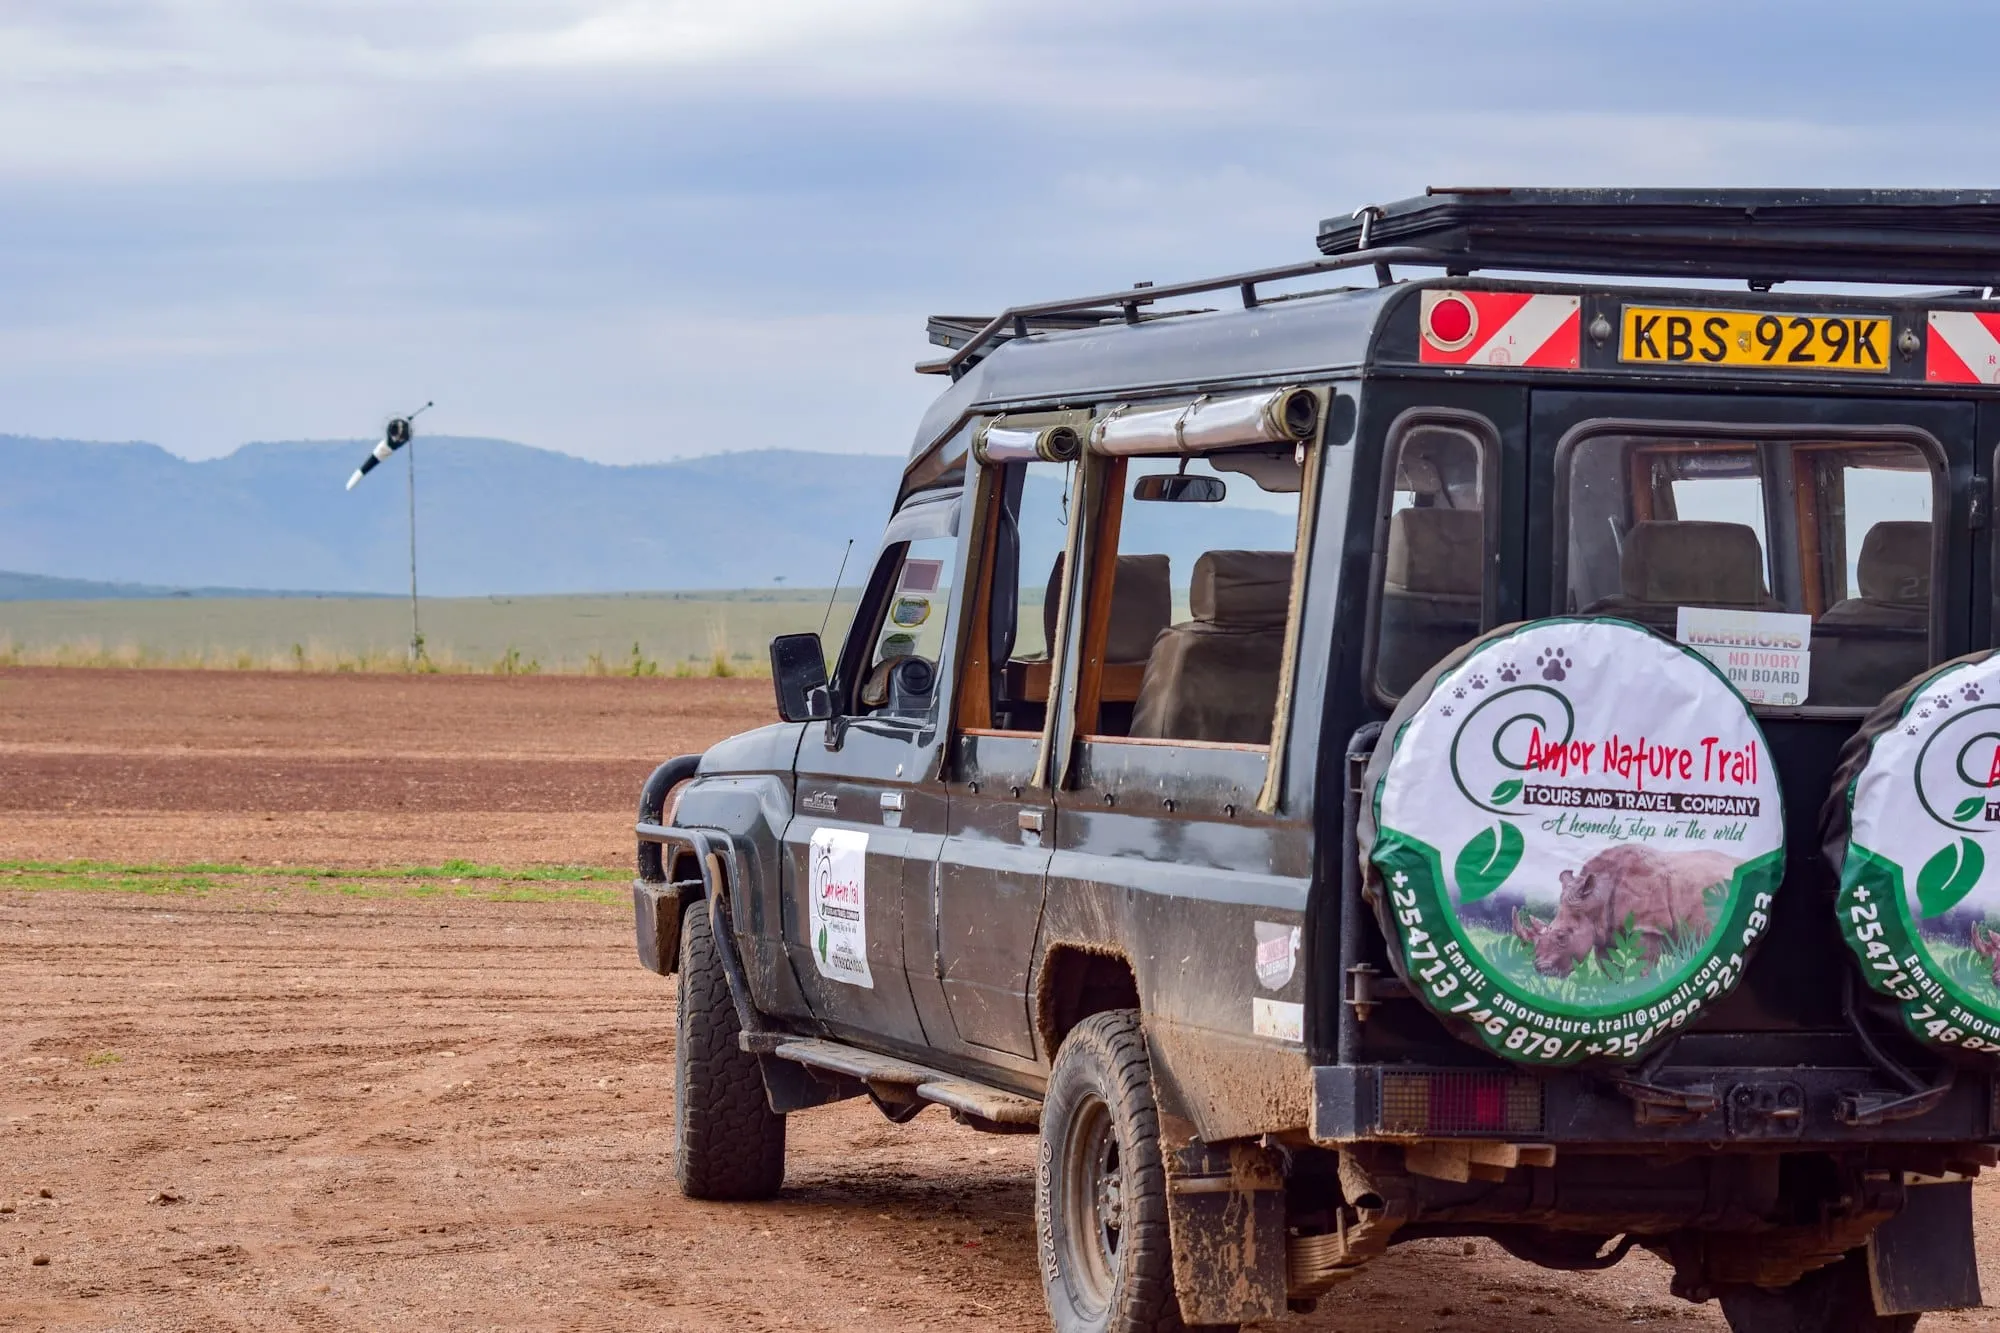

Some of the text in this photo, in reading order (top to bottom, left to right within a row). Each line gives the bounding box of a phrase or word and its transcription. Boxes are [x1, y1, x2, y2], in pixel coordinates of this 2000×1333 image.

[1509, 335, 1516, 345] L
[1634, 315, 1882, 364] KBS 929K
[1988, 354, 1997, 365] R
[1728, 652, 1800, 668] NO IVORY
[1728, 668, 1800, 685] ON BOARD
[1524, 727, 1757, 791] Amor Nature Trail
[1526, 787, 1757, 815] TOURS AND TRAVEL COMPANY
[1569, 812, 1628, 840] homely
[1626, 817, 1656, 841] step
[1664, 823, 1678, 837] in
[1676, 820, 1706, 840] the
[1713, 821, 1747, 841] wild
[1392, 871, 1459, 998] +254713
[1705, 953, 1743, 1000] 221
[1443, 940, 1722, 1034] Email: amornature.trail@gmail.com
[1850, 885, 2000, 1056] +254713 746 87
[1904, 954, 1945, 1004] Email:
